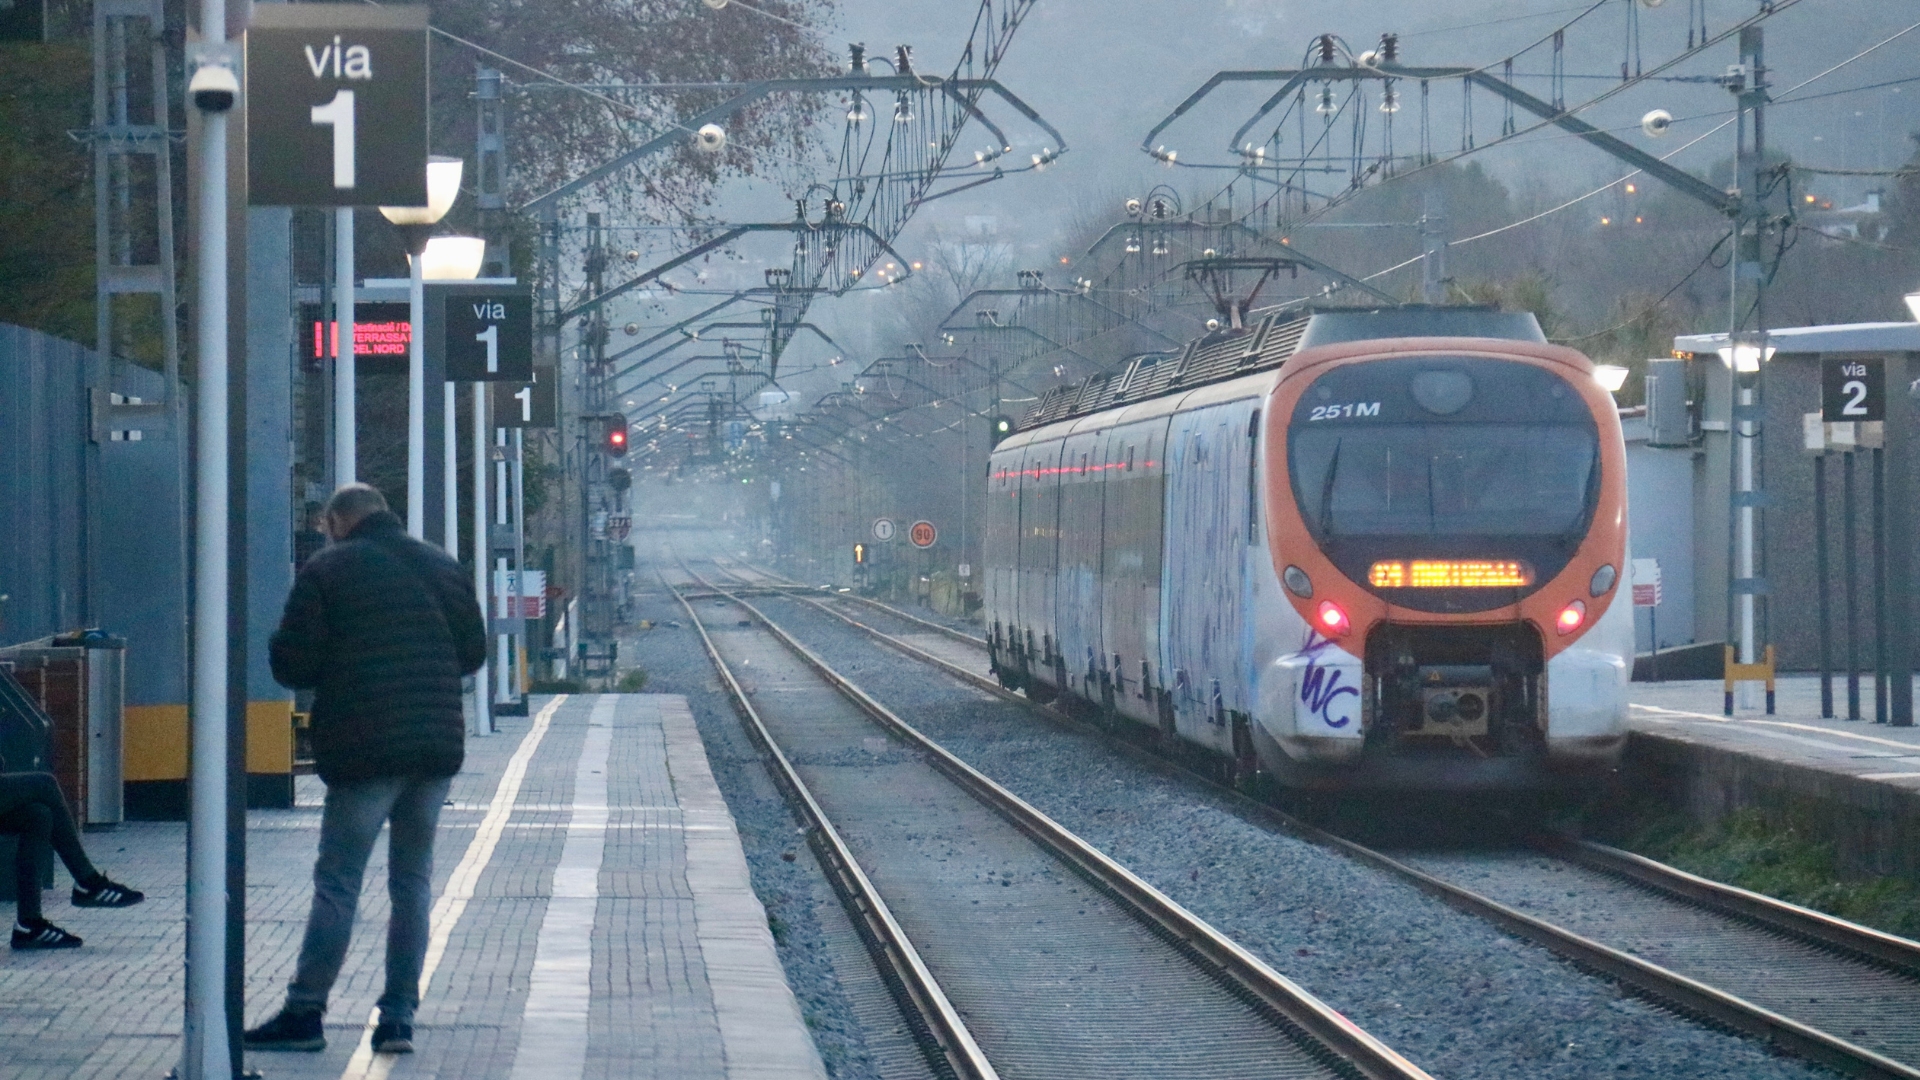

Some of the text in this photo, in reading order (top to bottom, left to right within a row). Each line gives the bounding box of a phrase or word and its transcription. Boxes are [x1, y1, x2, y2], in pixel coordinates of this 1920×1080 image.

[304, 35, 372, 79] via
[311, 90, 355, 188] 1
[473, 299, 506, 319] via
[373, 344, 405, 354] NORD
[475, 325, 498, 373] 1
[1842, 361, 1867, 376] via
[514, 387, 531, 421] 1
[1842, 380, 1868, 415] 2
[1310, 402, 1381, 421] 251M
[916, 528, 931, 541] 90
